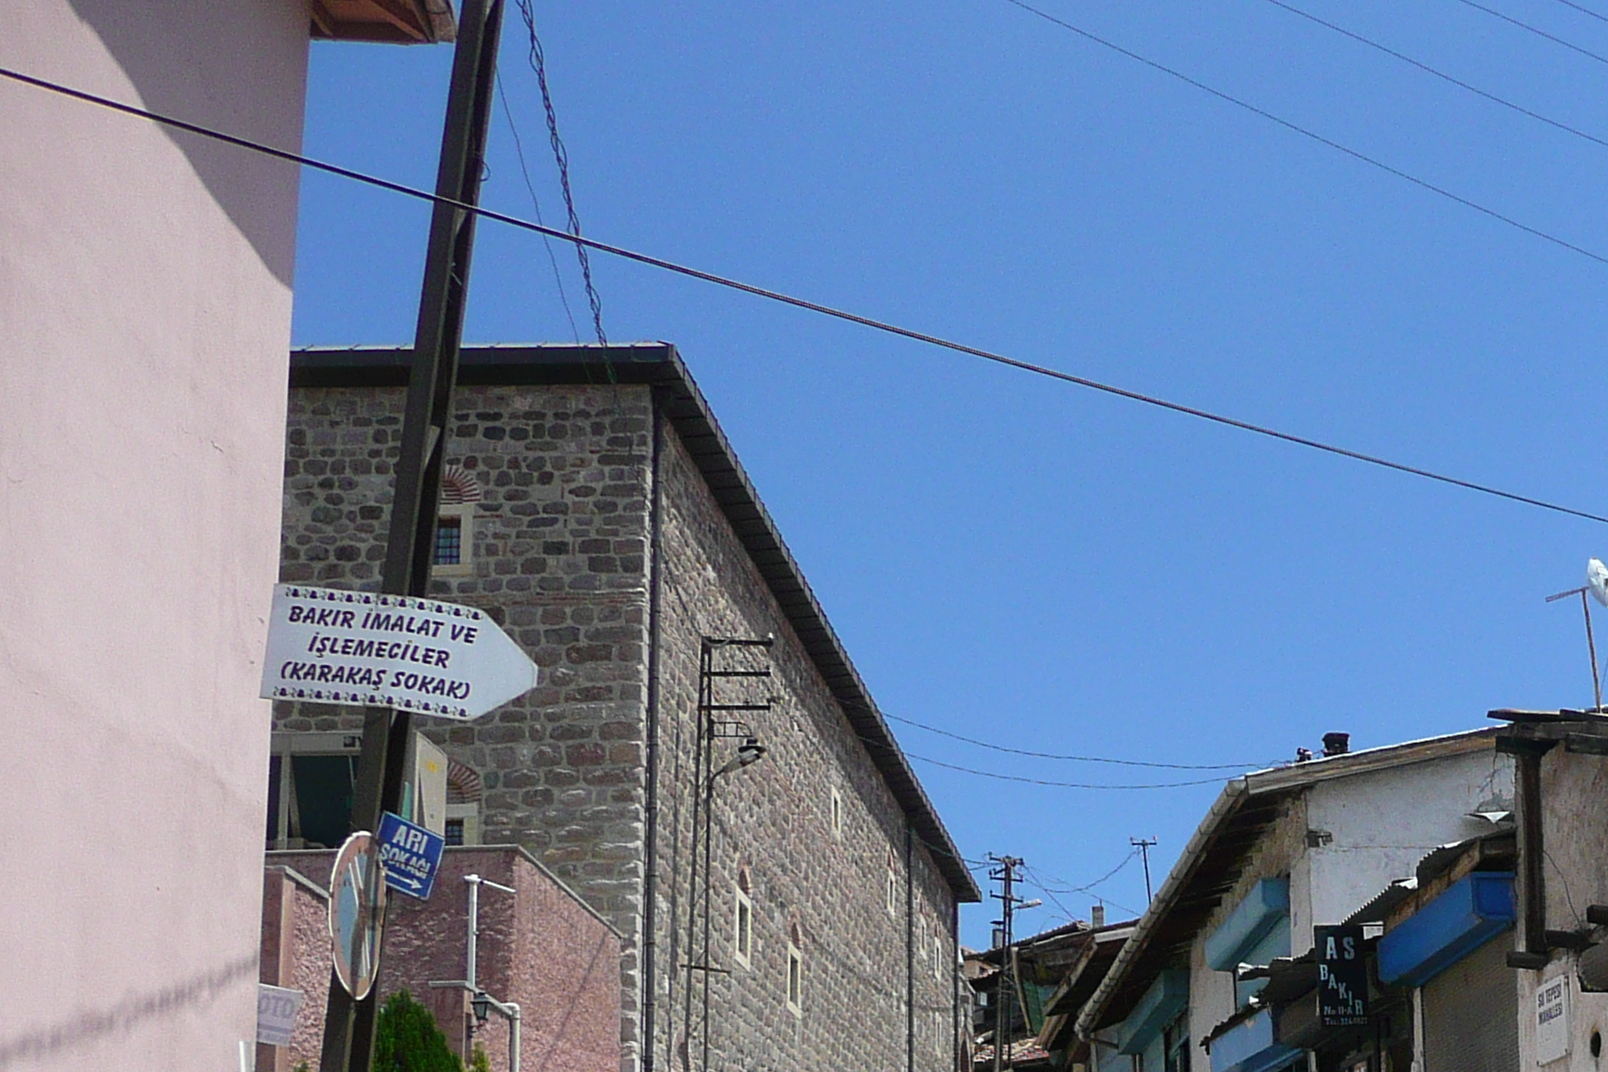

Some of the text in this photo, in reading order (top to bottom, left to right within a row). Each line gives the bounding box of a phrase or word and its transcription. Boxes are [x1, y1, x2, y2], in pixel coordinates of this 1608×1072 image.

[288, 605, 478, 645] BAKIR İMALAT VE
[308, 632, 450, 669] İŞLEMECİLER
[280, 660, 471, 700] (KARAKAŞ SOKAK)
[391, 825, 428, 855] ARI
[1319, 964, 1363, 1015] BAKIR
